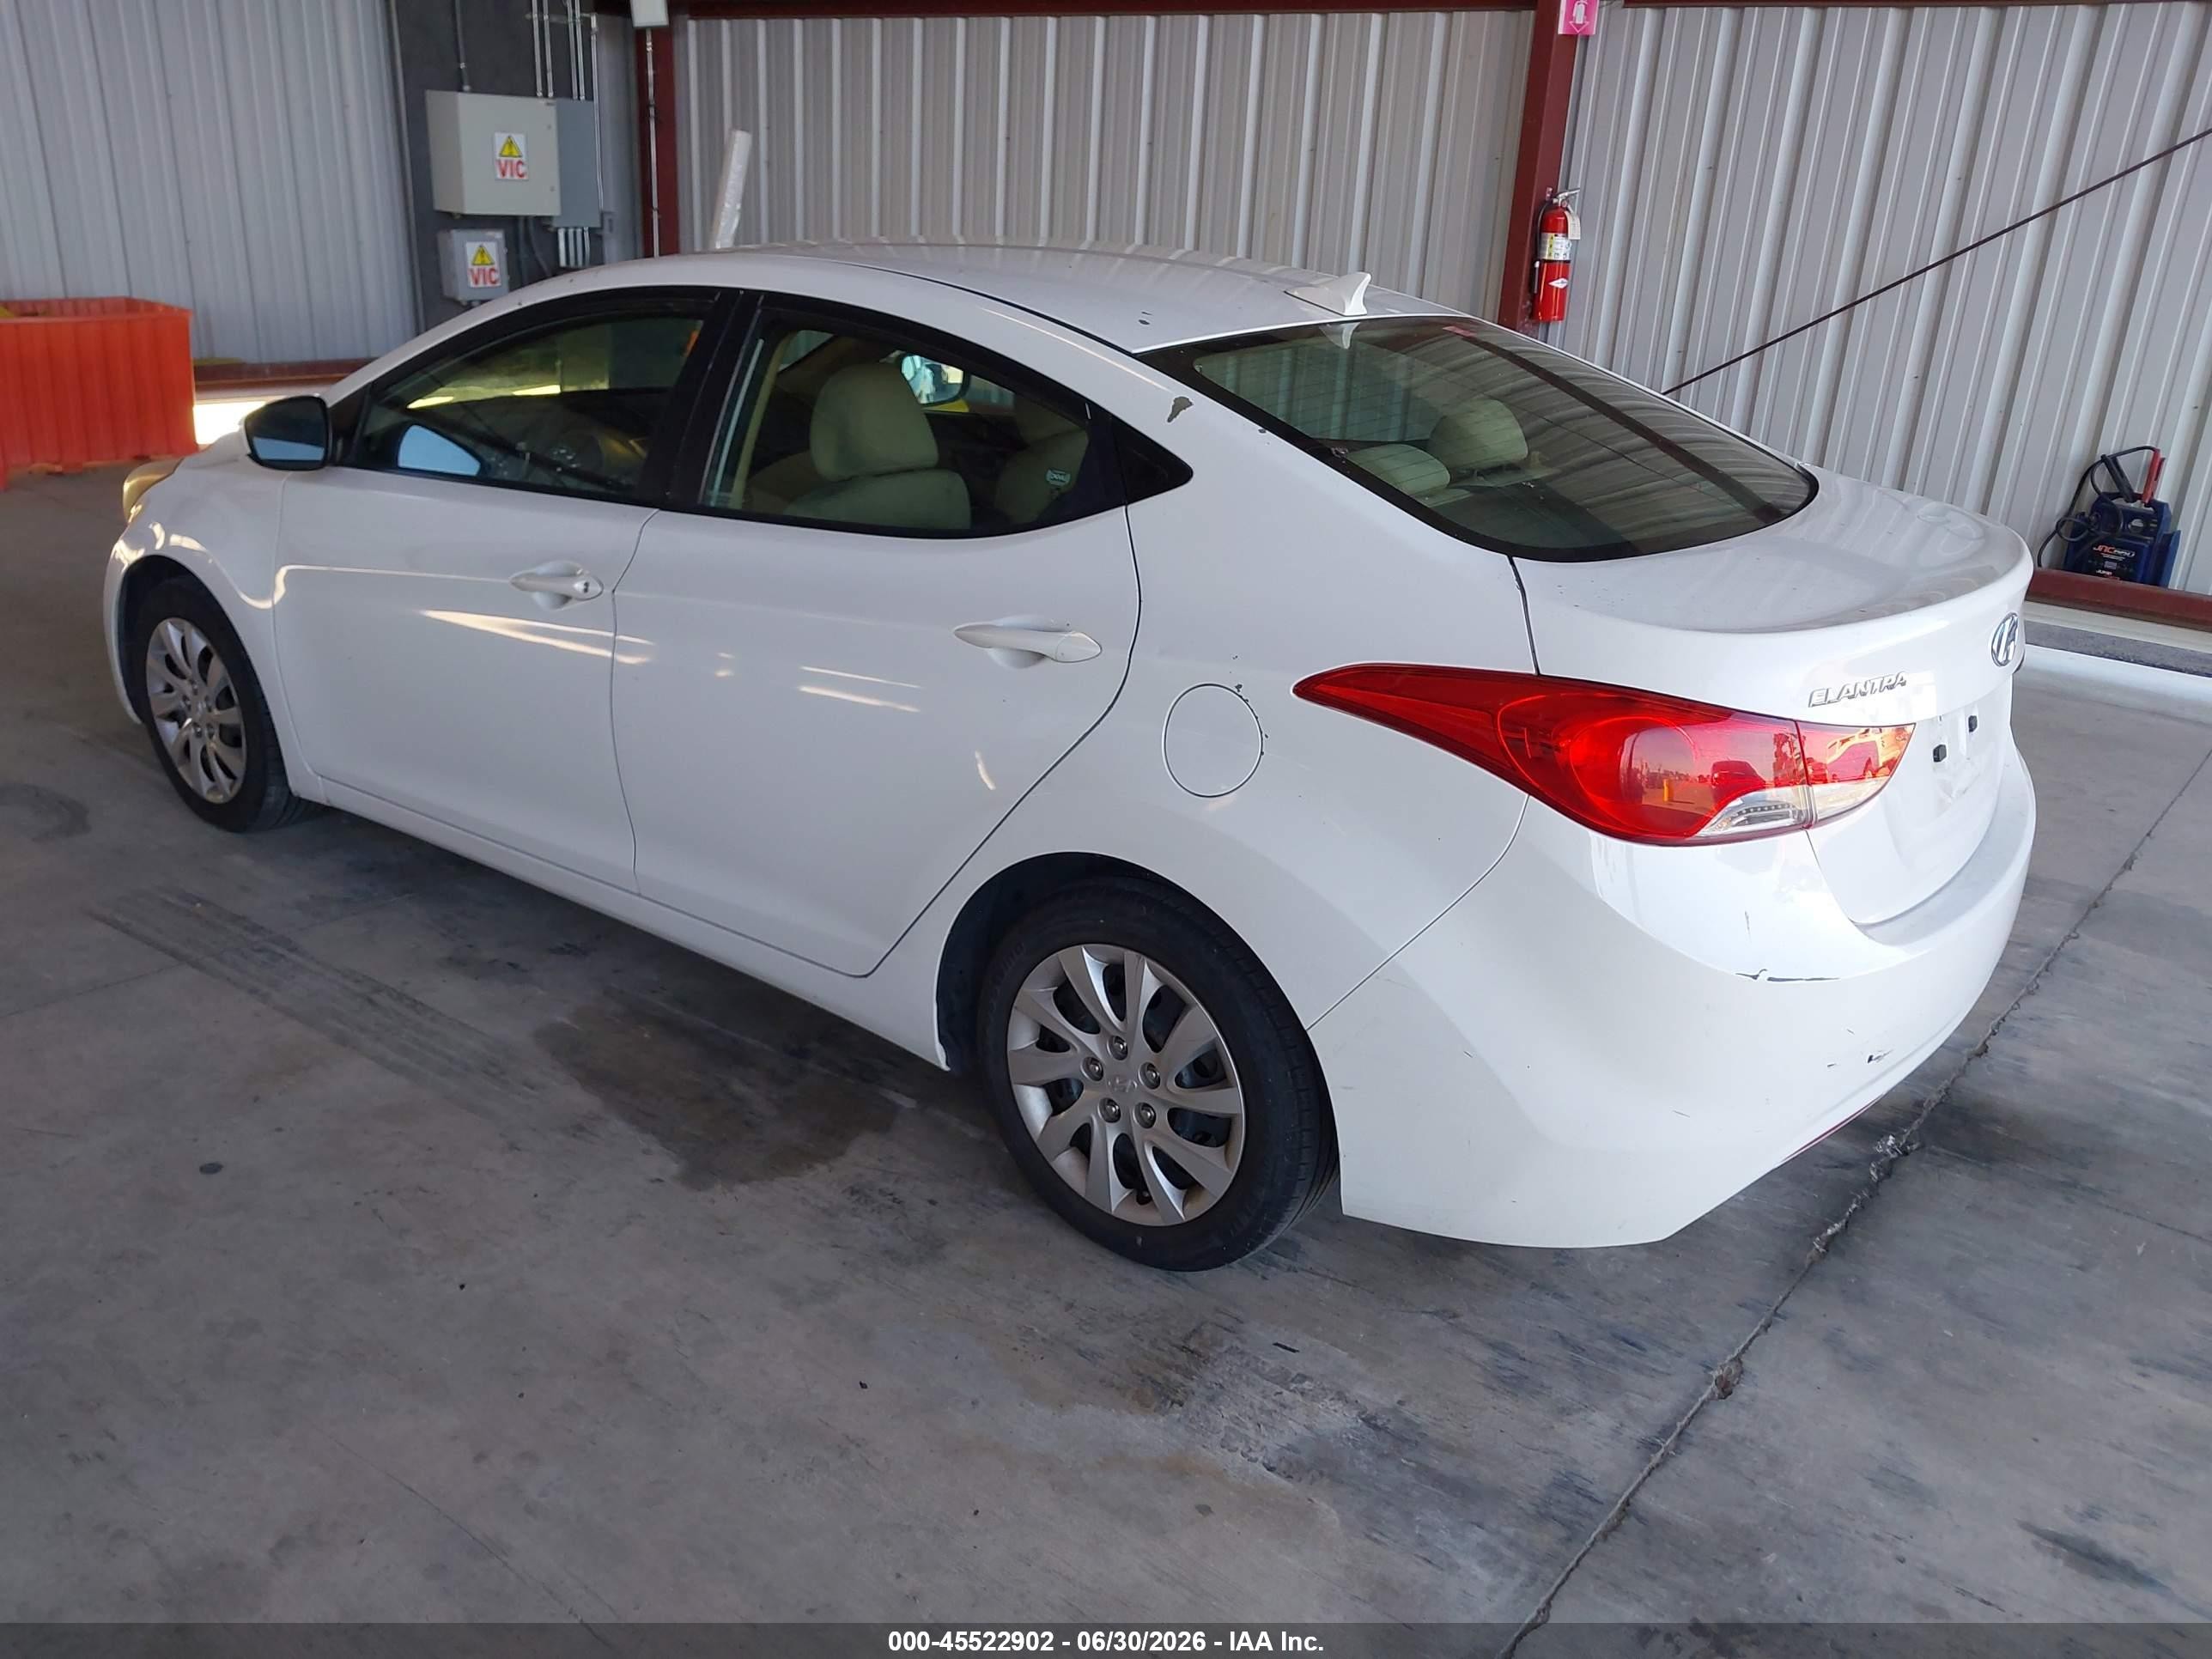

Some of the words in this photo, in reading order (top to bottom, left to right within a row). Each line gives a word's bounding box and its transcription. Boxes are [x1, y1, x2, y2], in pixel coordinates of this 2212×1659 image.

[497, 160, 526, 179] VIC
[470, 268, 500, 285] VIC
[1808, 672, 1907, 707] ELANTRA
